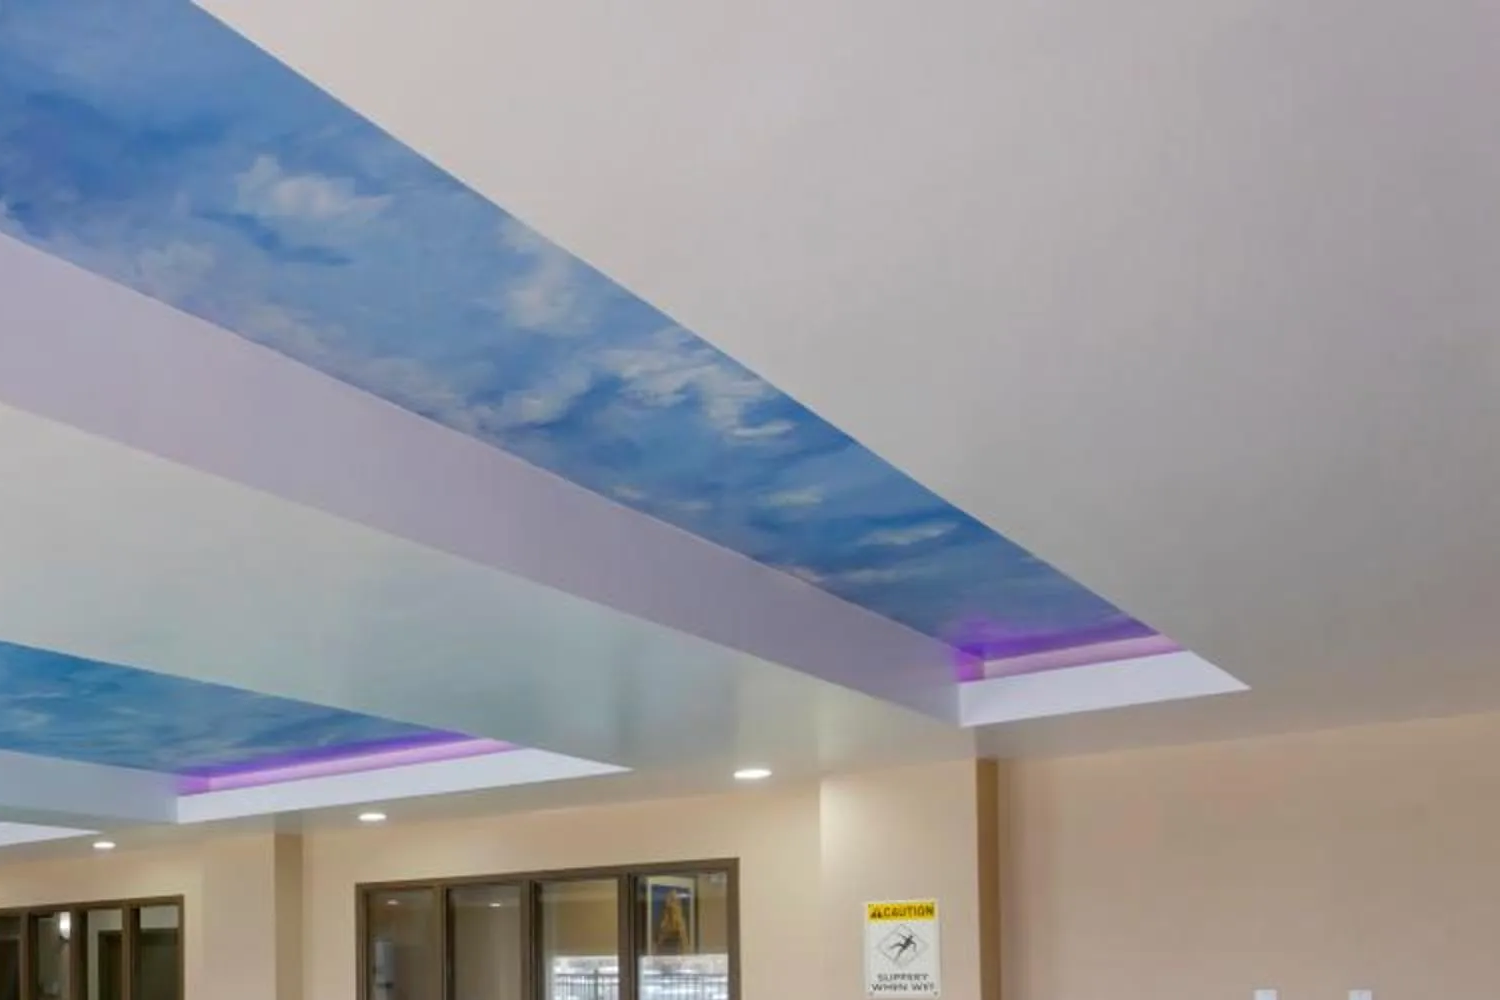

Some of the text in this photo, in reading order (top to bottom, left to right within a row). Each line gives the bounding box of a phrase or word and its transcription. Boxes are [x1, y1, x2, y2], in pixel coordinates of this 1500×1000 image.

[883, 905, 935, 918] CAUTION
[877, 972, 929, 982] SLIPPERY
[871, 982, 935, 992] WHEN WET
